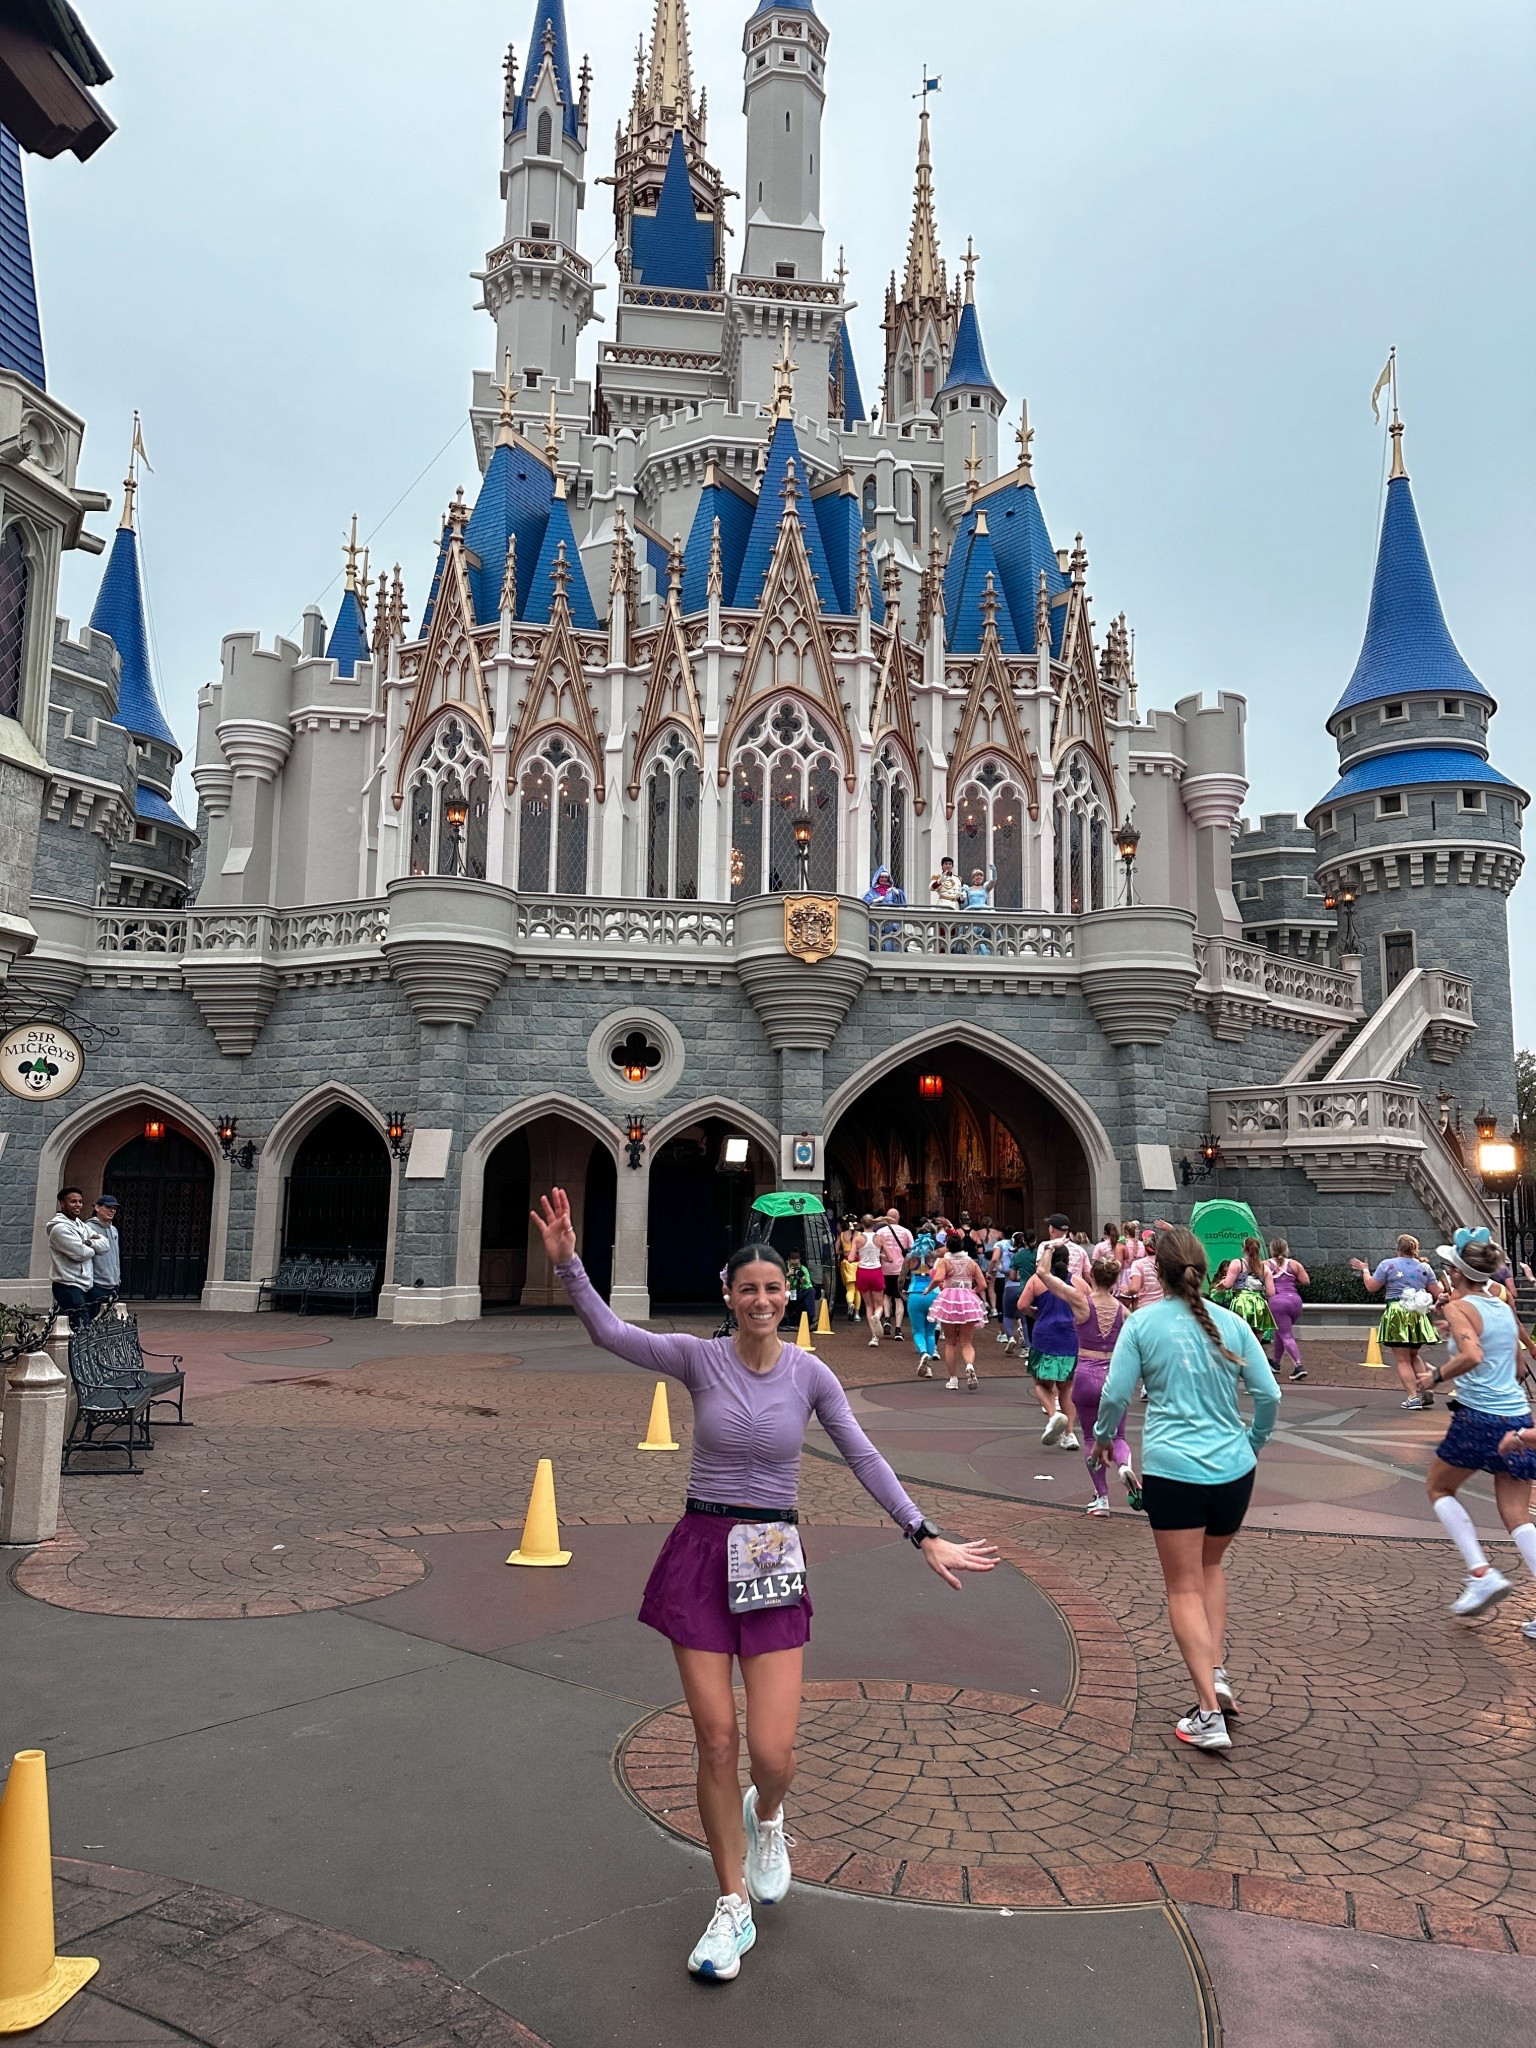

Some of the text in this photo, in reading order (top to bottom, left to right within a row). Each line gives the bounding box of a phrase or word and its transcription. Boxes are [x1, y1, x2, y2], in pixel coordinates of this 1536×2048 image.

[27, 1031, 56, 1043] SIR
[5, 1043, 76, 1062] MICKEY'S
[730, 1543, 739, 1574] 21134
[735, 1574, 804, 1603] 21134
